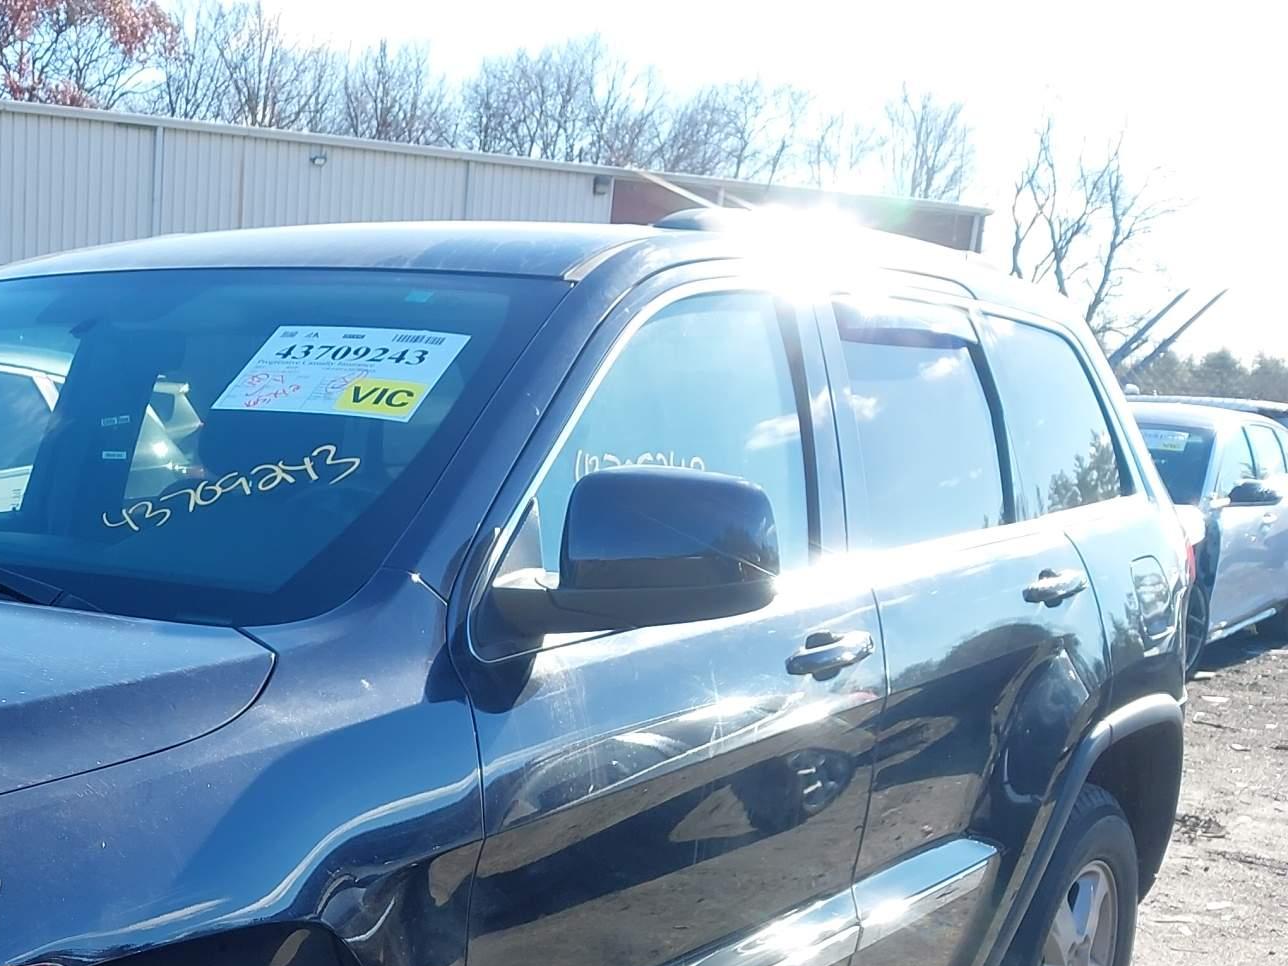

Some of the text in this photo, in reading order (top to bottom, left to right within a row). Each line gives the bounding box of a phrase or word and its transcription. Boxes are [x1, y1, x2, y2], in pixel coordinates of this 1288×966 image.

[274, 343, 429, 366] 43709243
[351, 385, 415, 408] VIC
[102, 444, 362, 532] 43709243
